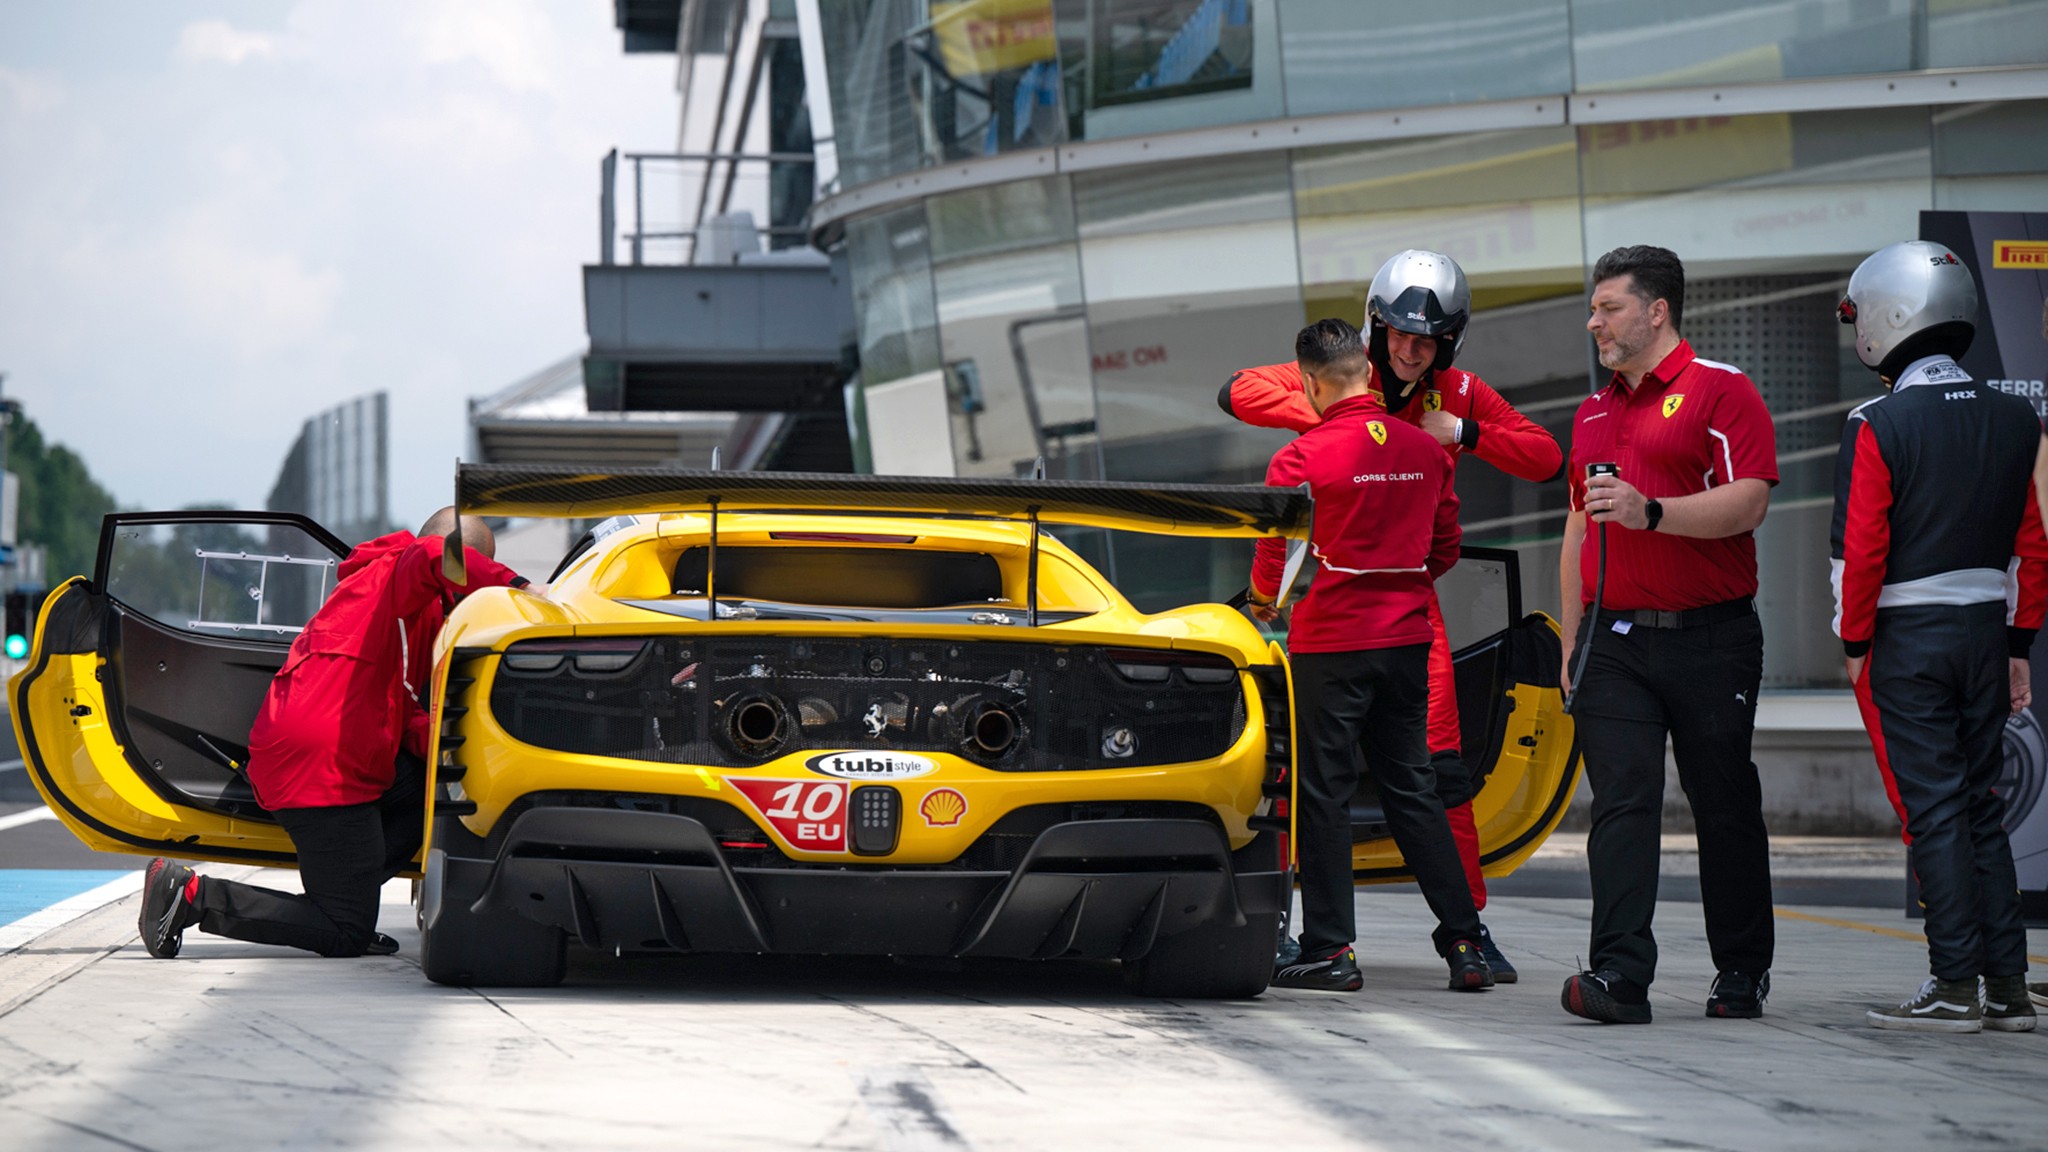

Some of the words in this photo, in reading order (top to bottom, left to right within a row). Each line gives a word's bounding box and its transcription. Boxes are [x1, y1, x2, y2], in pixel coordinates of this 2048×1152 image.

[2001, 246, 2048, 263] PIRE
[1407, 311, 1426, 321] Stilo
[1944, 390, 1977, 400] HRX
[1986, 380, 2048, 397] FERR
[1353, 474, 1387, 483] CORSE
[1389, 472, 1424, 481] CLIENTI
[832, 758, 893, 772] tubi
[894, 761, 921, 772] style
[766, 782, 843, 821] 10
[797, 823, 840, 841] EU
